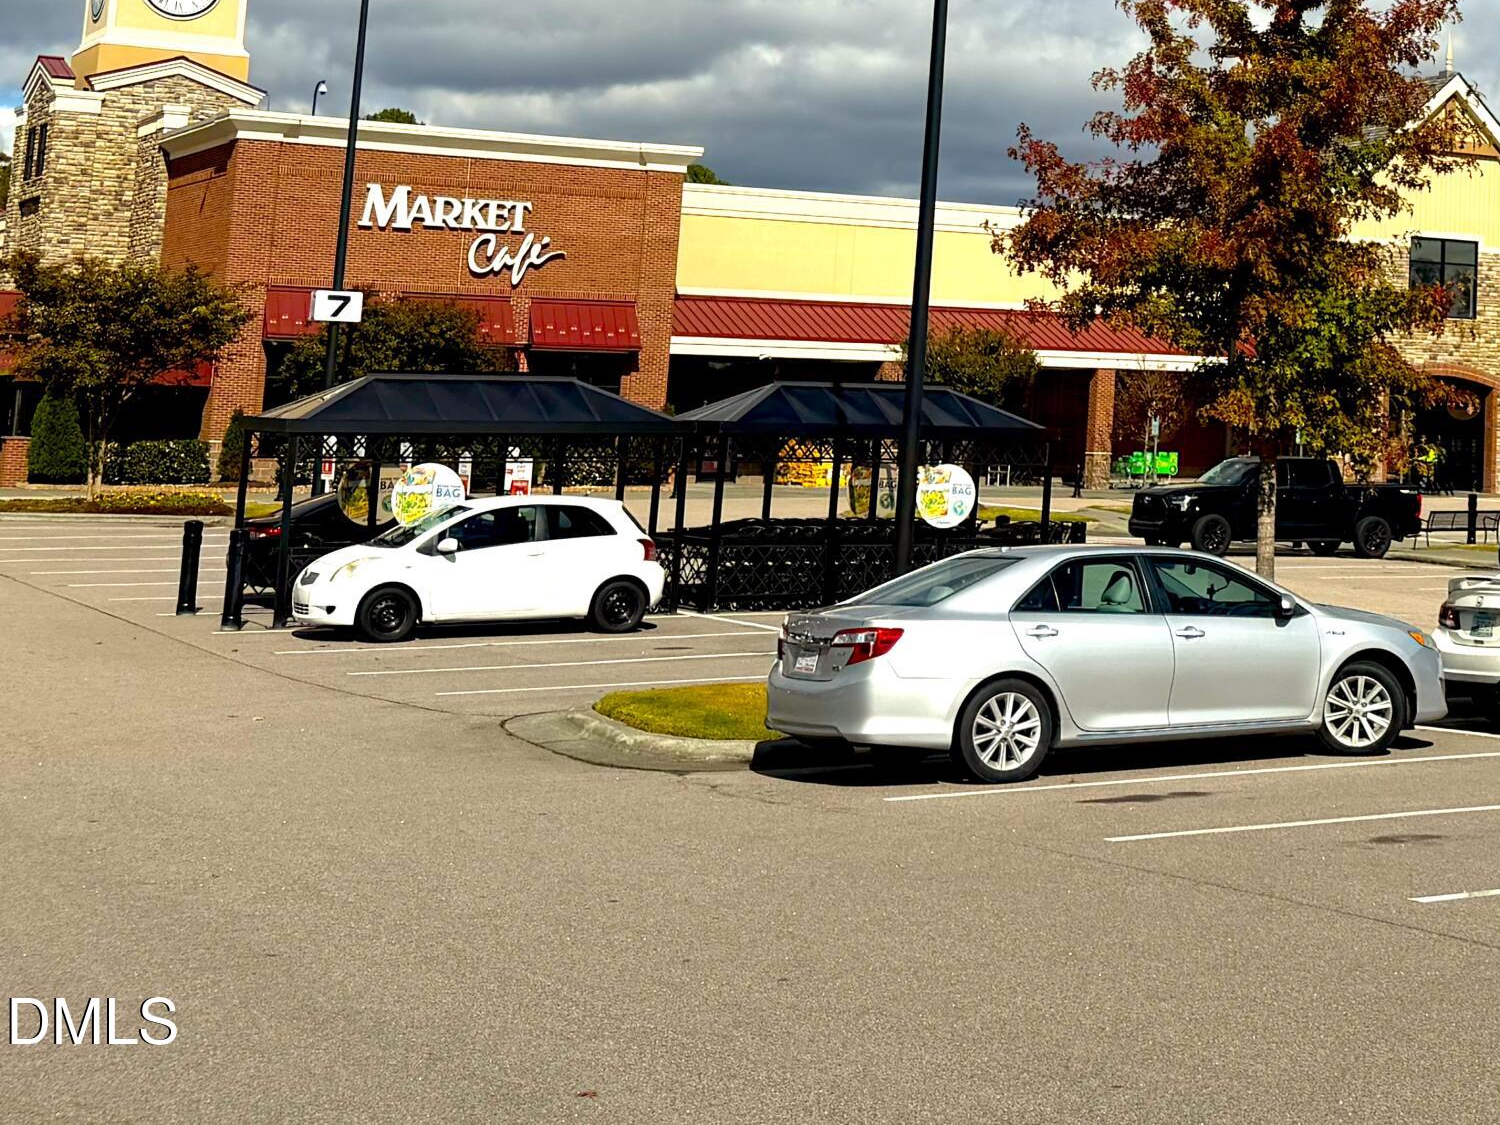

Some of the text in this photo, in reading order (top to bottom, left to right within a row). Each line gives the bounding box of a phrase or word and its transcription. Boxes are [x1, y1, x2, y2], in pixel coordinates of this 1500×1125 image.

[357, 182, 533, 232] MARKET
[467, 233, 567, 285] Café
[327, 294, 351, 317] 7
[380, 480, 396, 490] BA
[436, 488, 461, 498] BAG
[952, 487, 972, 496] BAG
